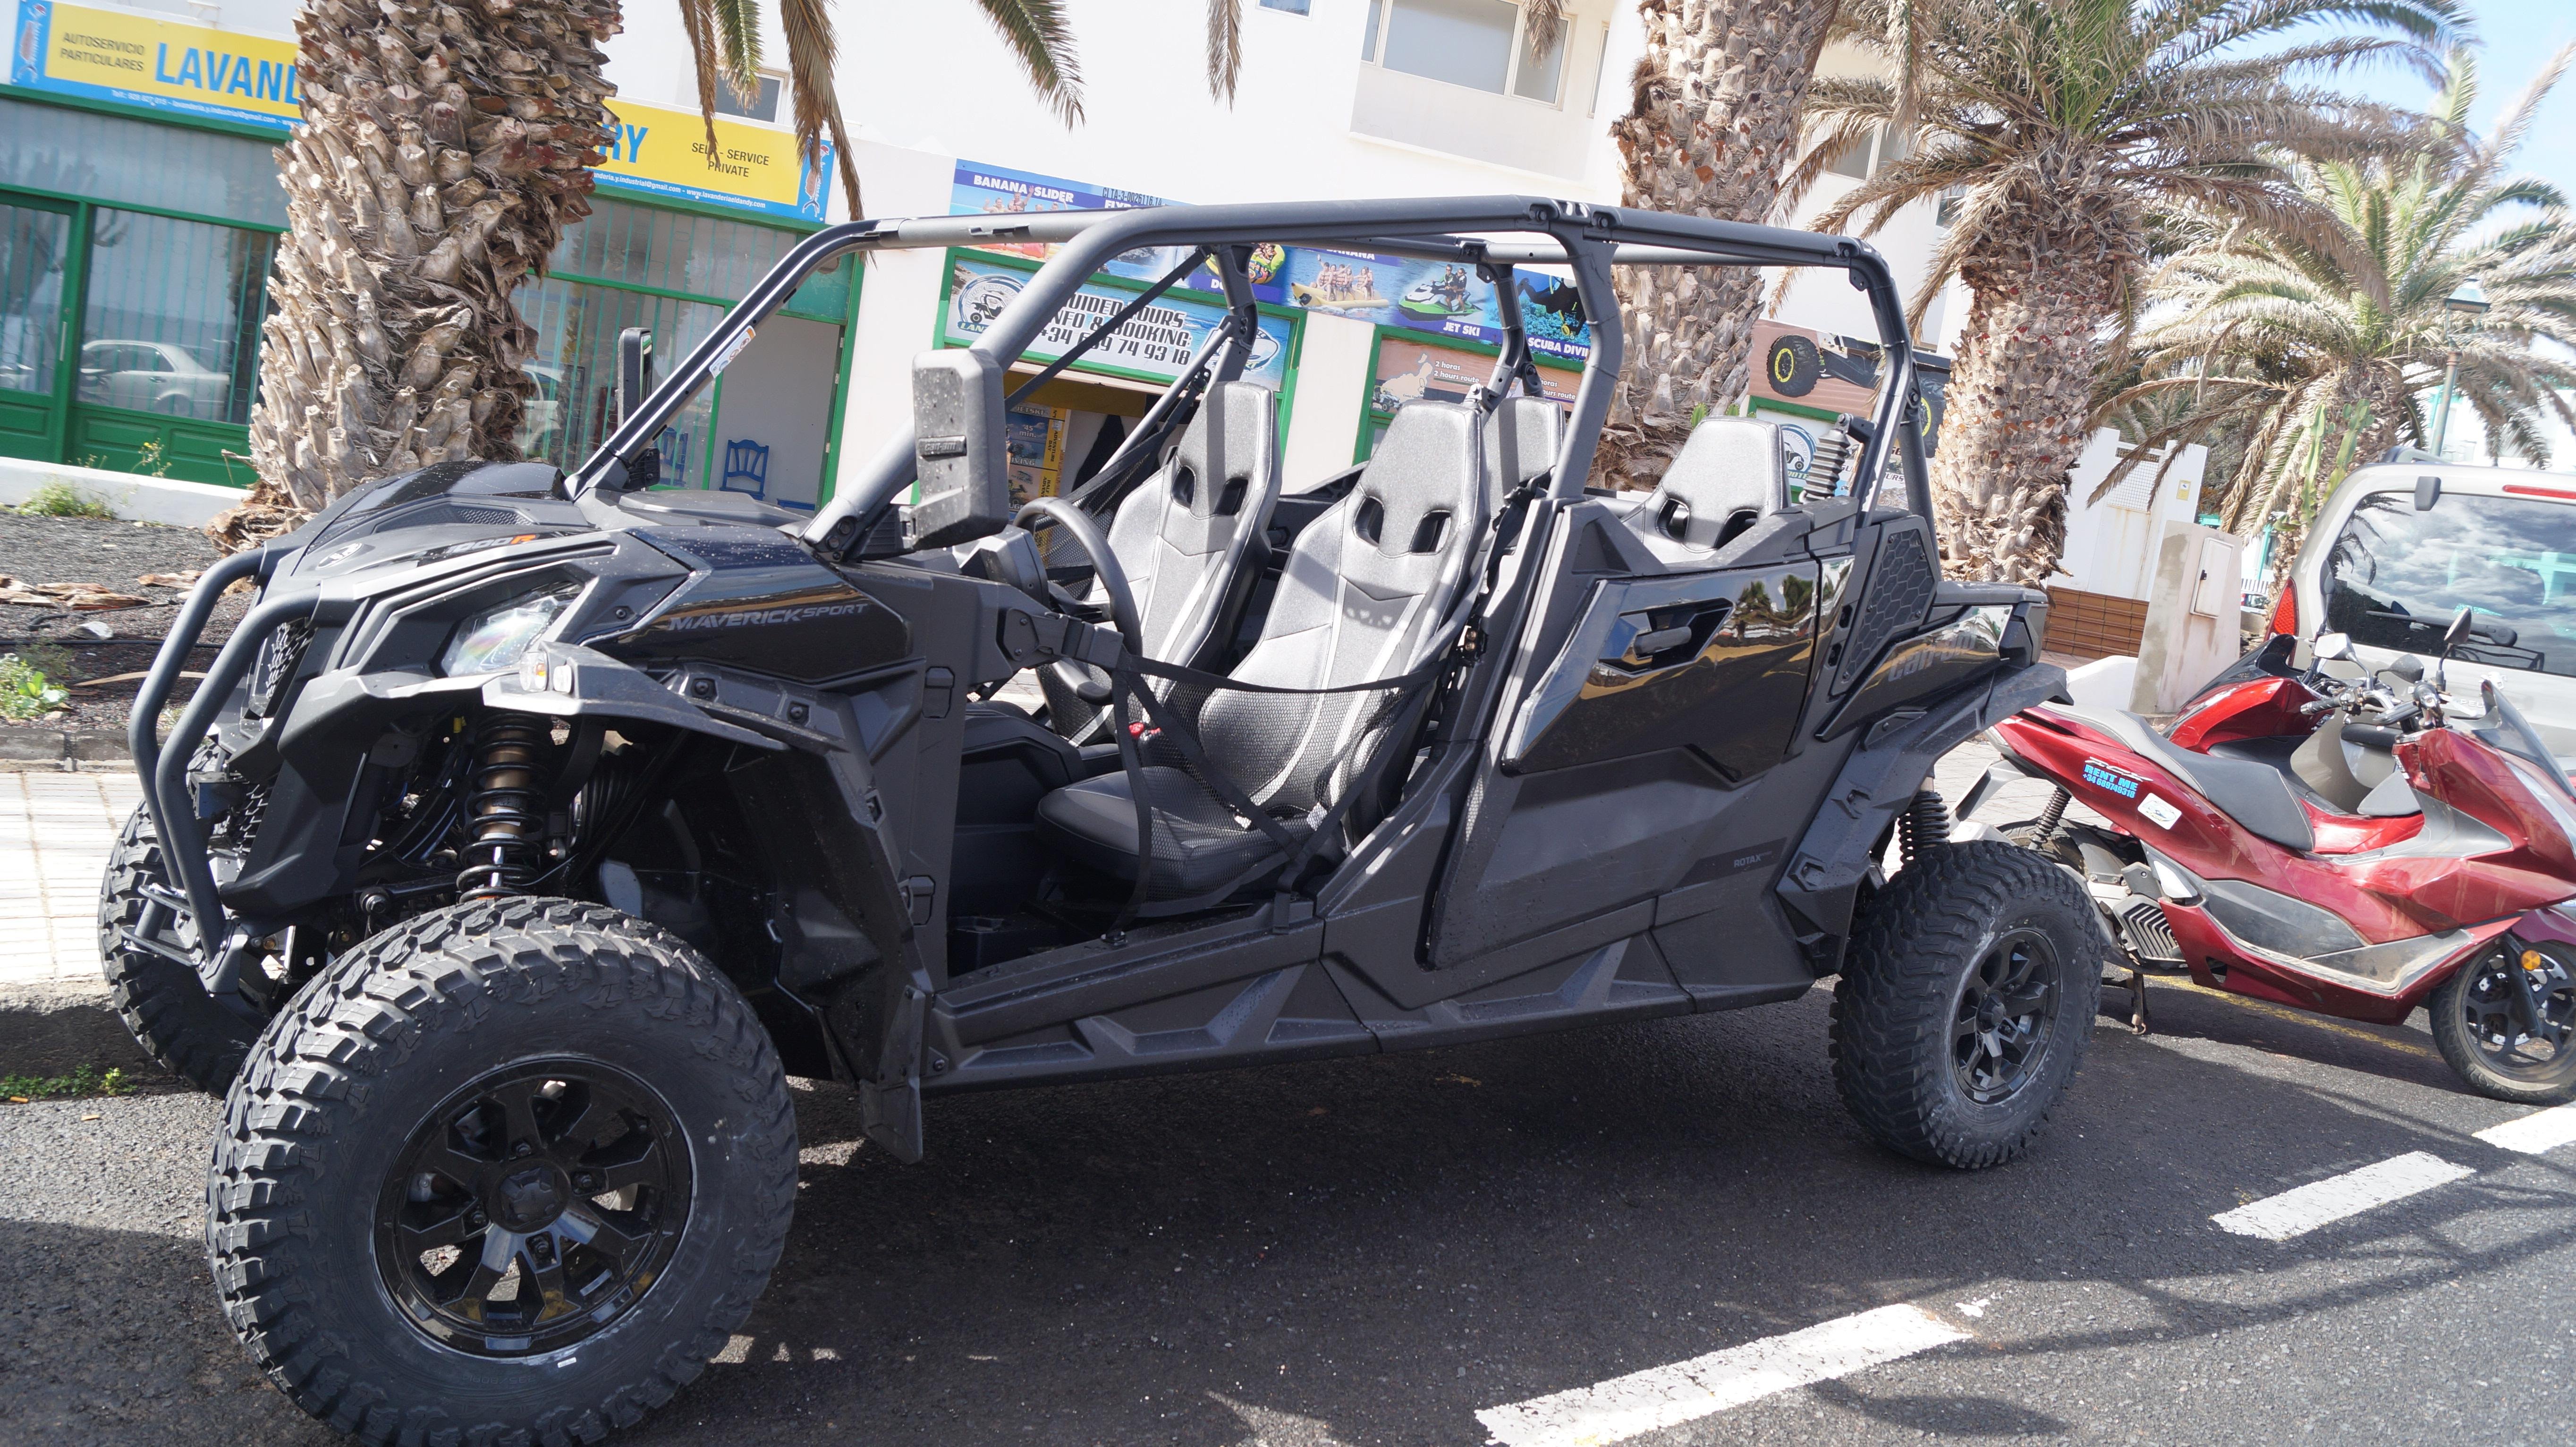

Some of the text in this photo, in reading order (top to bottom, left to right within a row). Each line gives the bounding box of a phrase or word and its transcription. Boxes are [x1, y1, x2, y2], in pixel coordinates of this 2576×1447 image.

[63, 32, 144, 55] AUTOSERVICIO
[60, 47, 144, 71] PARTICULARES
[691, 142, 711, 155] SEL
[727, 149, 770, 166] SERVICE
[707, 161, 750, 178] PRIVATE
[686, 189, 766, 208] www.lavanderiaeldandy.com
[974, 175, 1074, 203] BANANA SLIDER
[1090, 316, 1103, 331] &
[1134, 306, 1186, 328] OURS
[1443, 322, 1480, 337] JET SKI
[1041, 327, 1191, 366] +34 69 74 93 18
[1528, 337, 1561, 352] SCUBA
[1440, 371, 1459, 381] hours
[1460, 375, 1480, 383] route
[1441, 361, 1460, 371] horas
[1016, 406, 1044, 416] JETSKI
[1050, 430, 1059, 462] ADVENTURE
[669, 604, 869, 631] MAVERICK SPORT
[2082, 773, 2136, 799] +34 689749318
[2084, 764, 2138, 792] RENT ME
[1733, 854, 1762, 868] ROTAX
